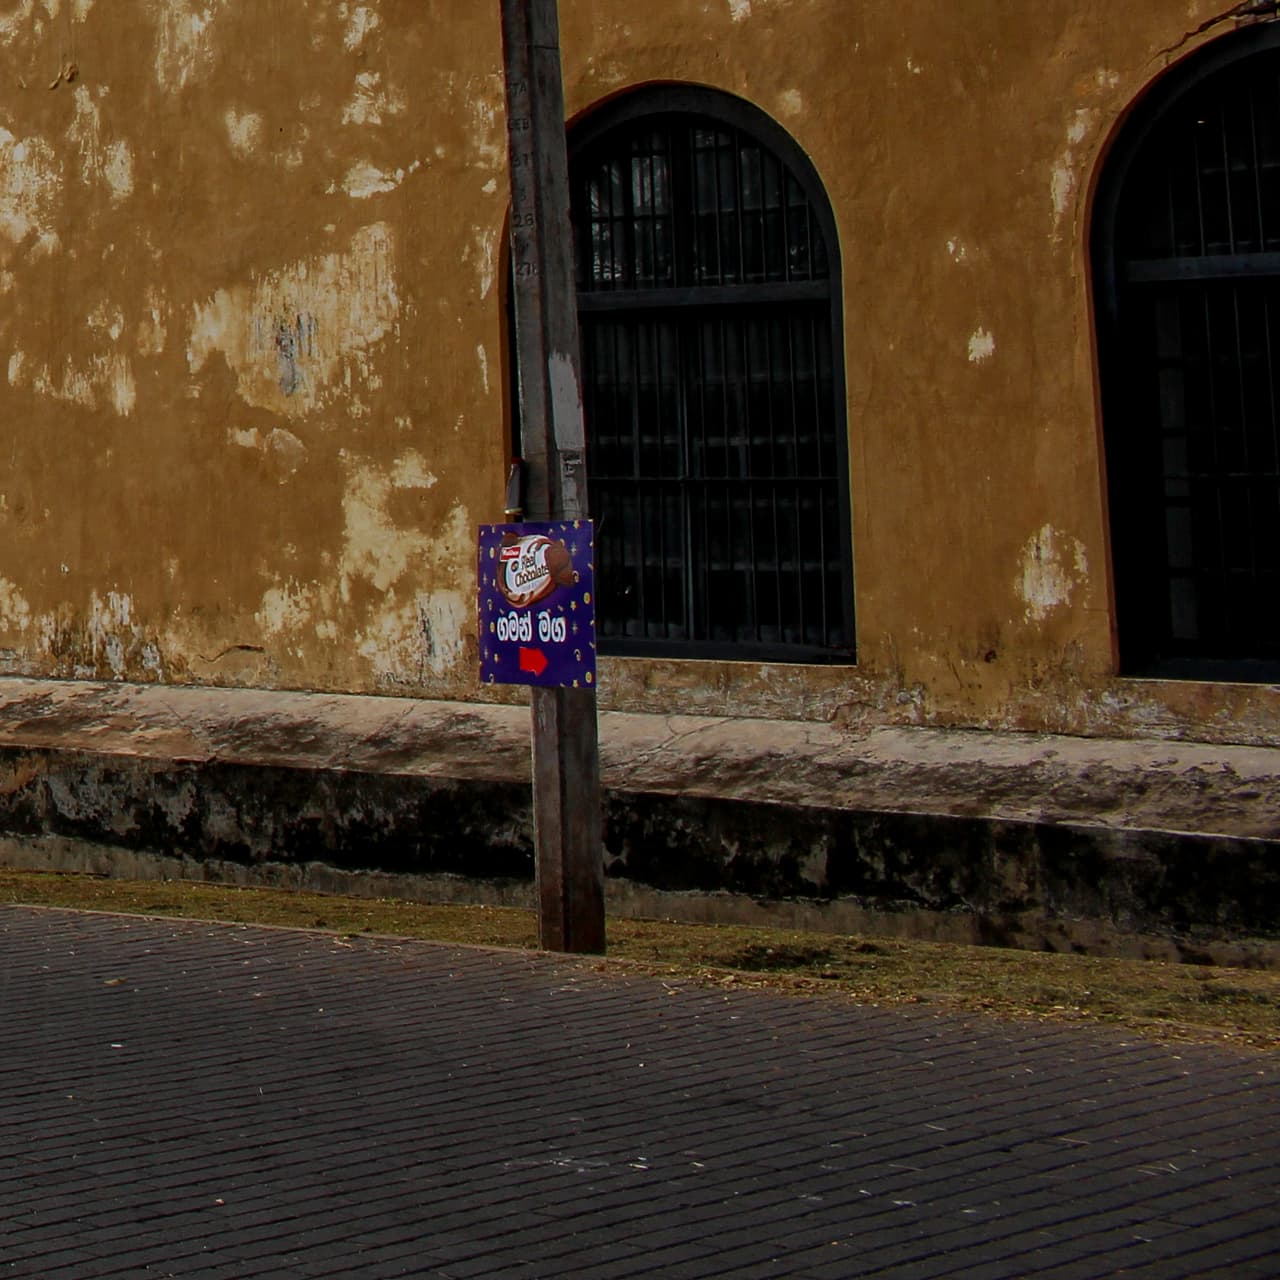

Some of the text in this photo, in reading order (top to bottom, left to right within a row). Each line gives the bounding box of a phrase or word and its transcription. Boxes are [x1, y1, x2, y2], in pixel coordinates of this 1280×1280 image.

[515, 564, 550, 588] Chocolate
[497, 610, 567, 642] ගමන් මග
